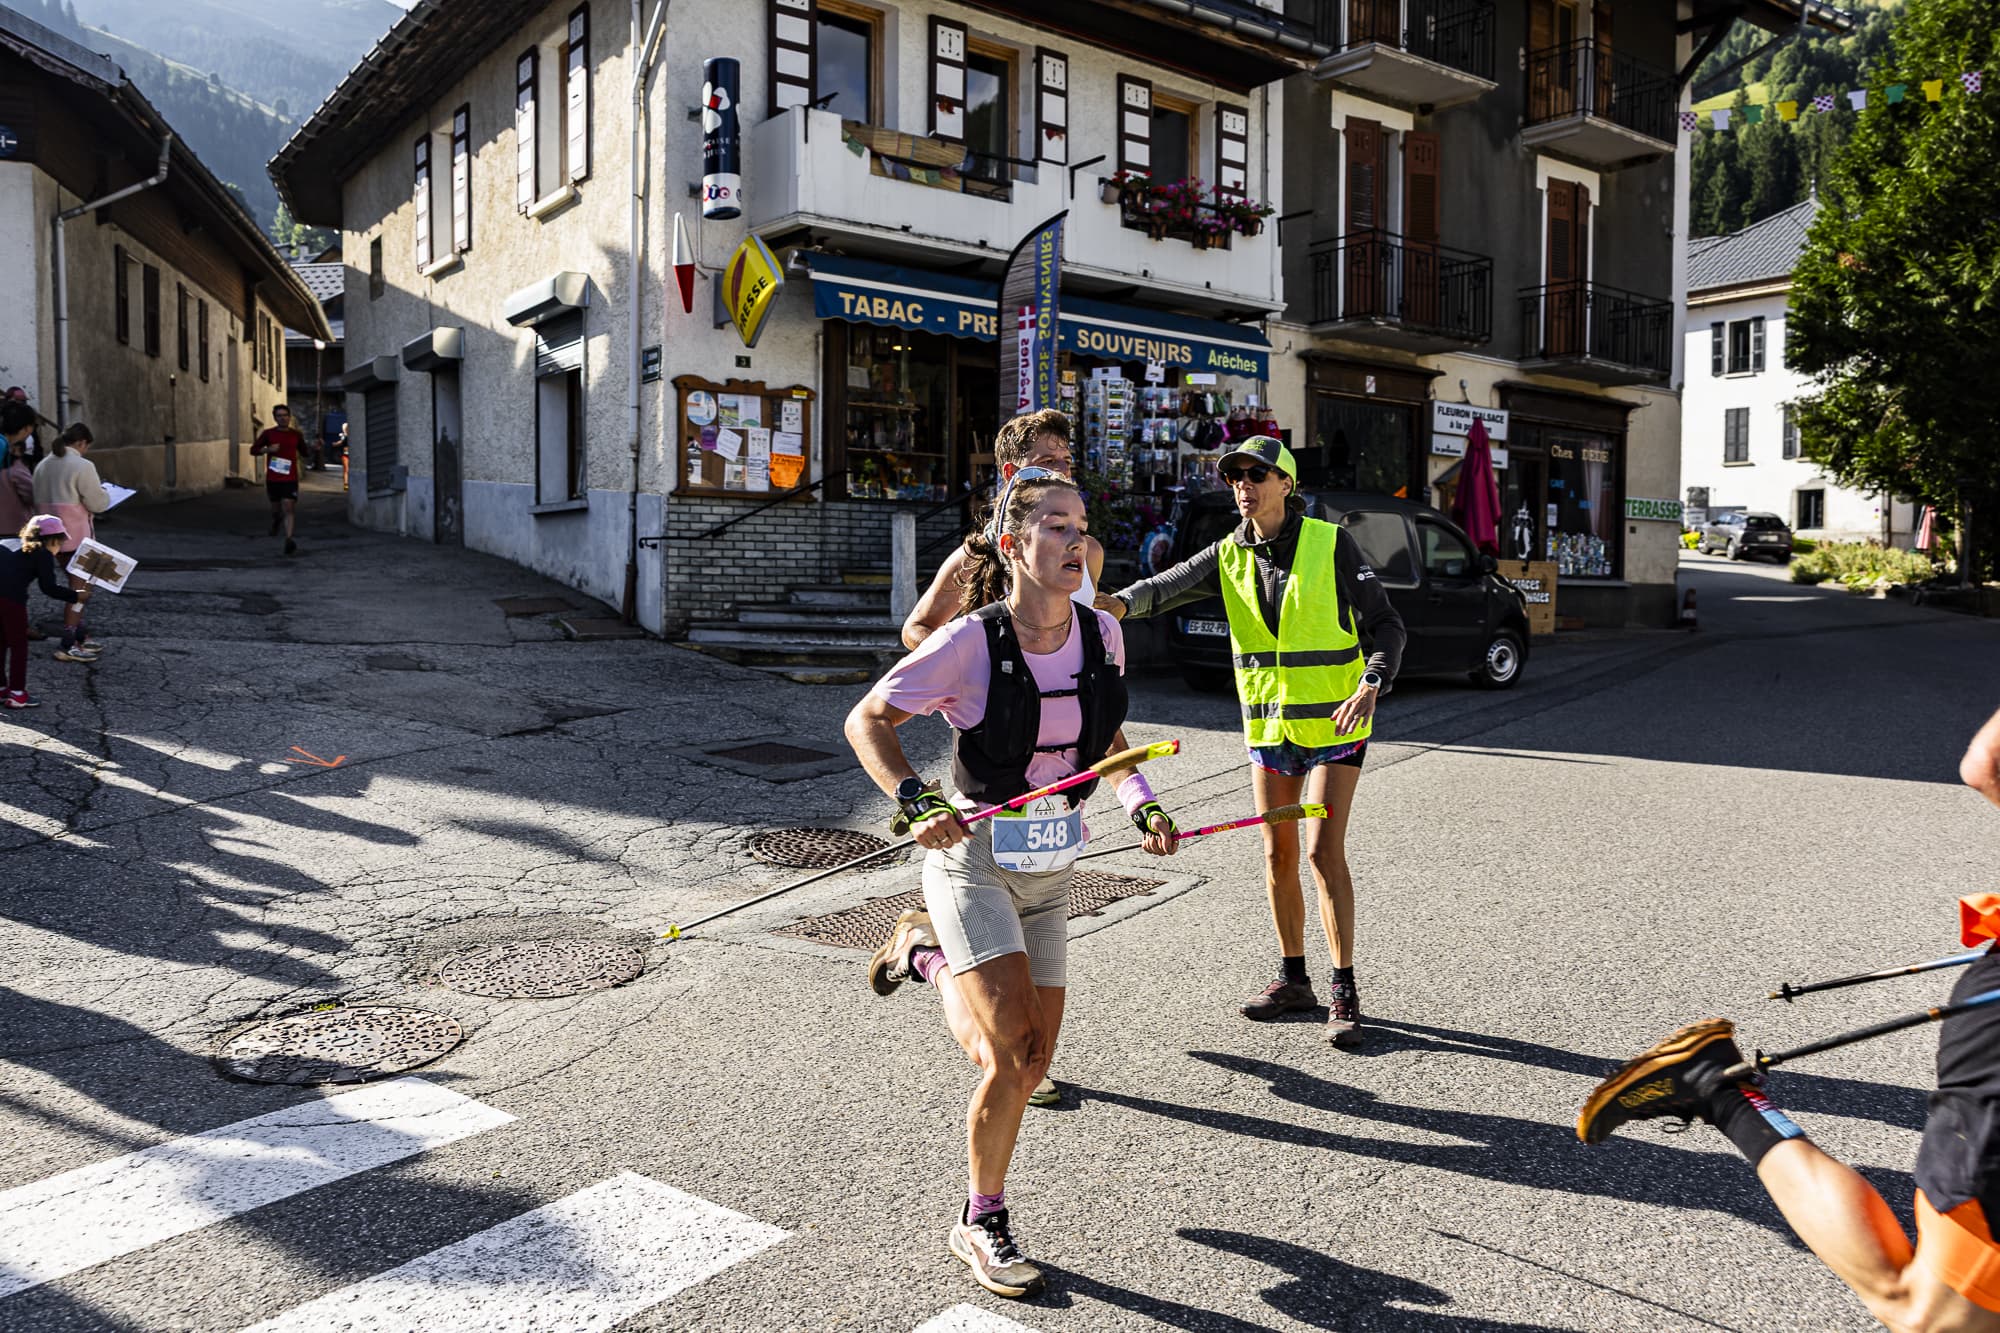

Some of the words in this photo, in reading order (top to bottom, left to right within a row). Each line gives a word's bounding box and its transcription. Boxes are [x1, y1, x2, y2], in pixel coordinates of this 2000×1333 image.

[738, 276, 768, 336] PRESSE
[838, 291, 924, 324] TABAC
[959, 310, 998, 336] PRE
[1077, 329, 1192, 364] SOUVENIRS
[1207, 349, 1258, 373] Arêches
[1437, 405, 1470, 419] FLEURON
[1625, 500, 1680, 519] TERRASSE
[1027, 820, 1068, 850] 548
